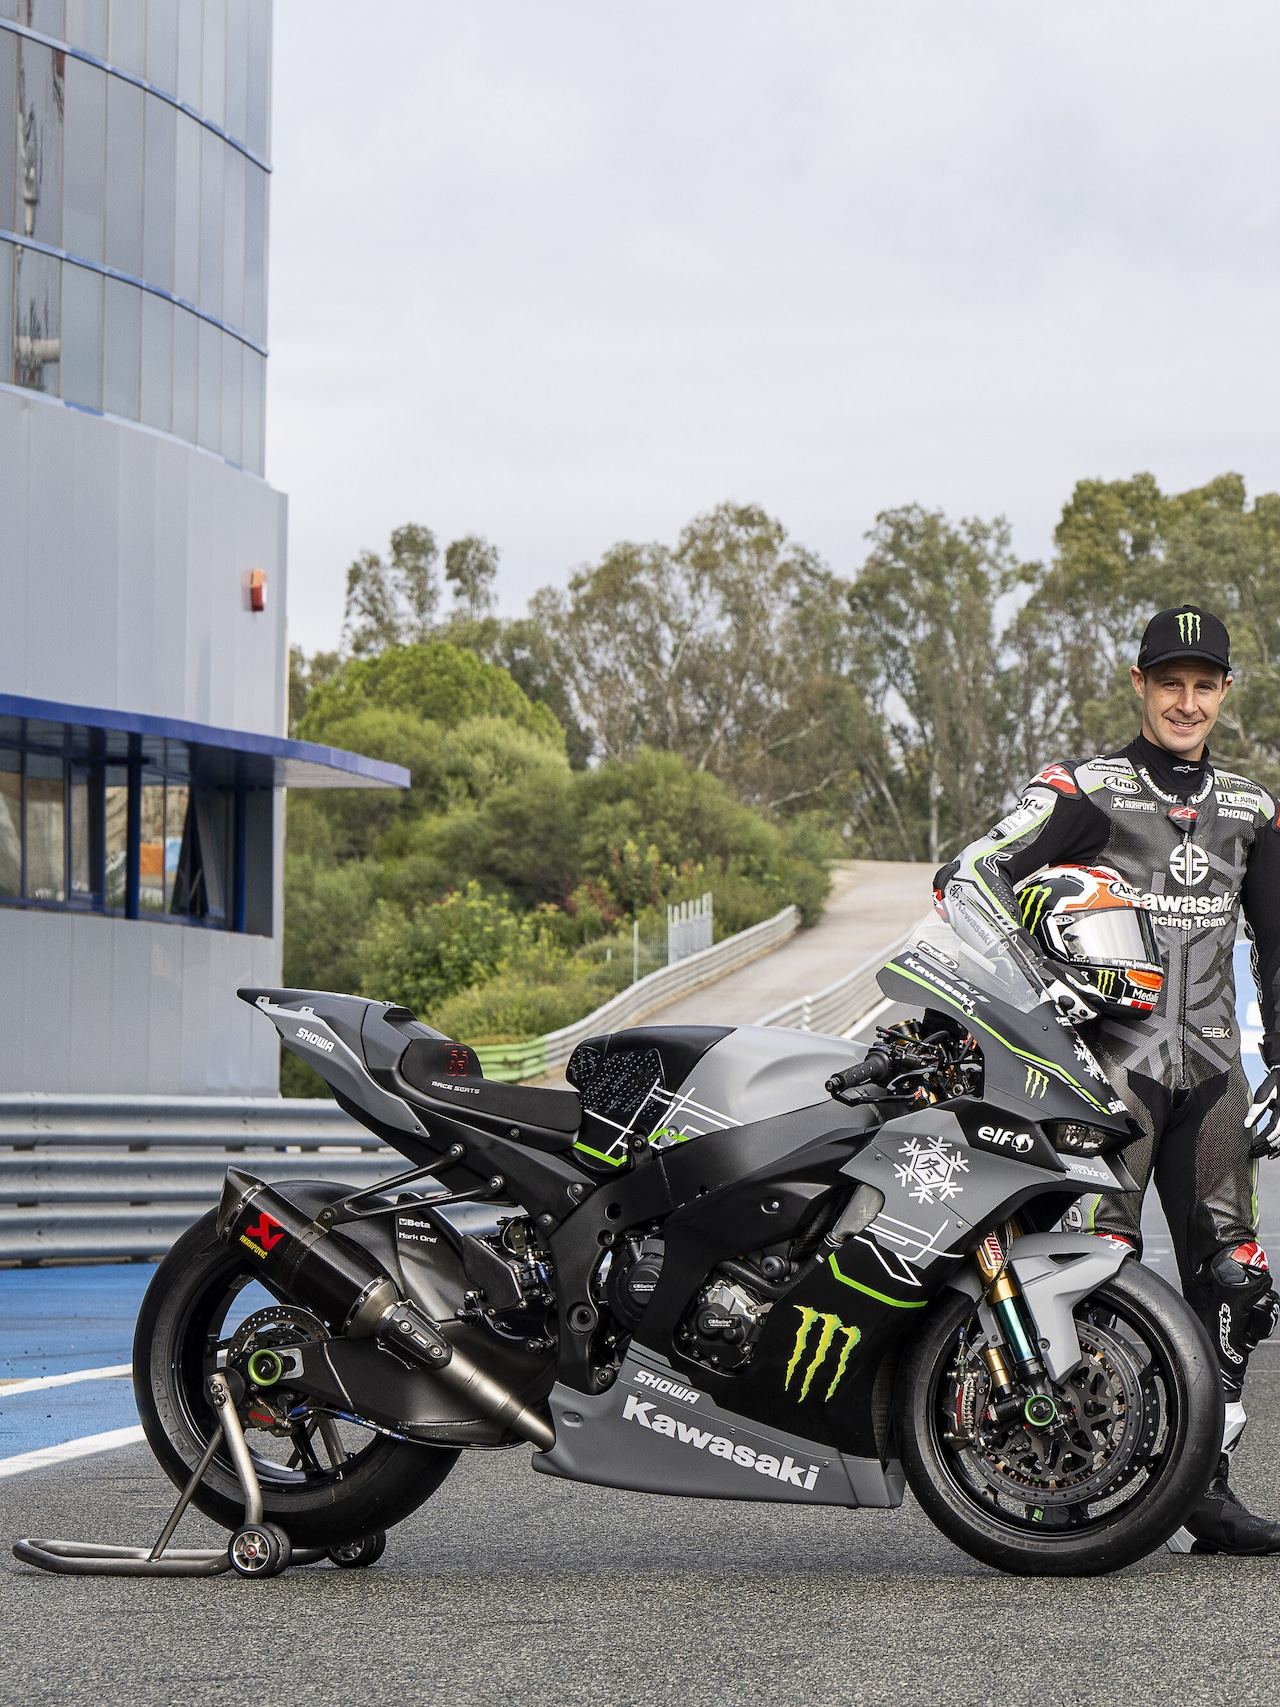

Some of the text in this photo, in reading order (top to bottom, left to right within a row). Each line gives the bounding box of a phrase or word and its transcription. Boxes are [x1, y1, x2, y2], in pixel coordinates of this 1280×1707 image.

[1106, 777, 1137, 791] Arai
[1138, 767, 1178, 804] Kawasaki
[1217, 808, 1255, 824] SHOWA
[1141, 892, 1237, 914] awasaki
[1194, 915, 1226, 928] Team
[904, 957, 977, 1007] Kawasaki
[296, 1027, 335, 1053] SHOWA
[1202, 1027, 1231, 1039] SBK
[431, 1080, 480, 1094] RACE SEATS
[977, 1126, 1014, 1146] elf
[407, 1219, 431, 1229] Beta
[398, 1232, 419, 1241] Mark
[633, 1370, 701, 1404] SHOWA
[622, 1394, 820, 1491] Kawasaki
